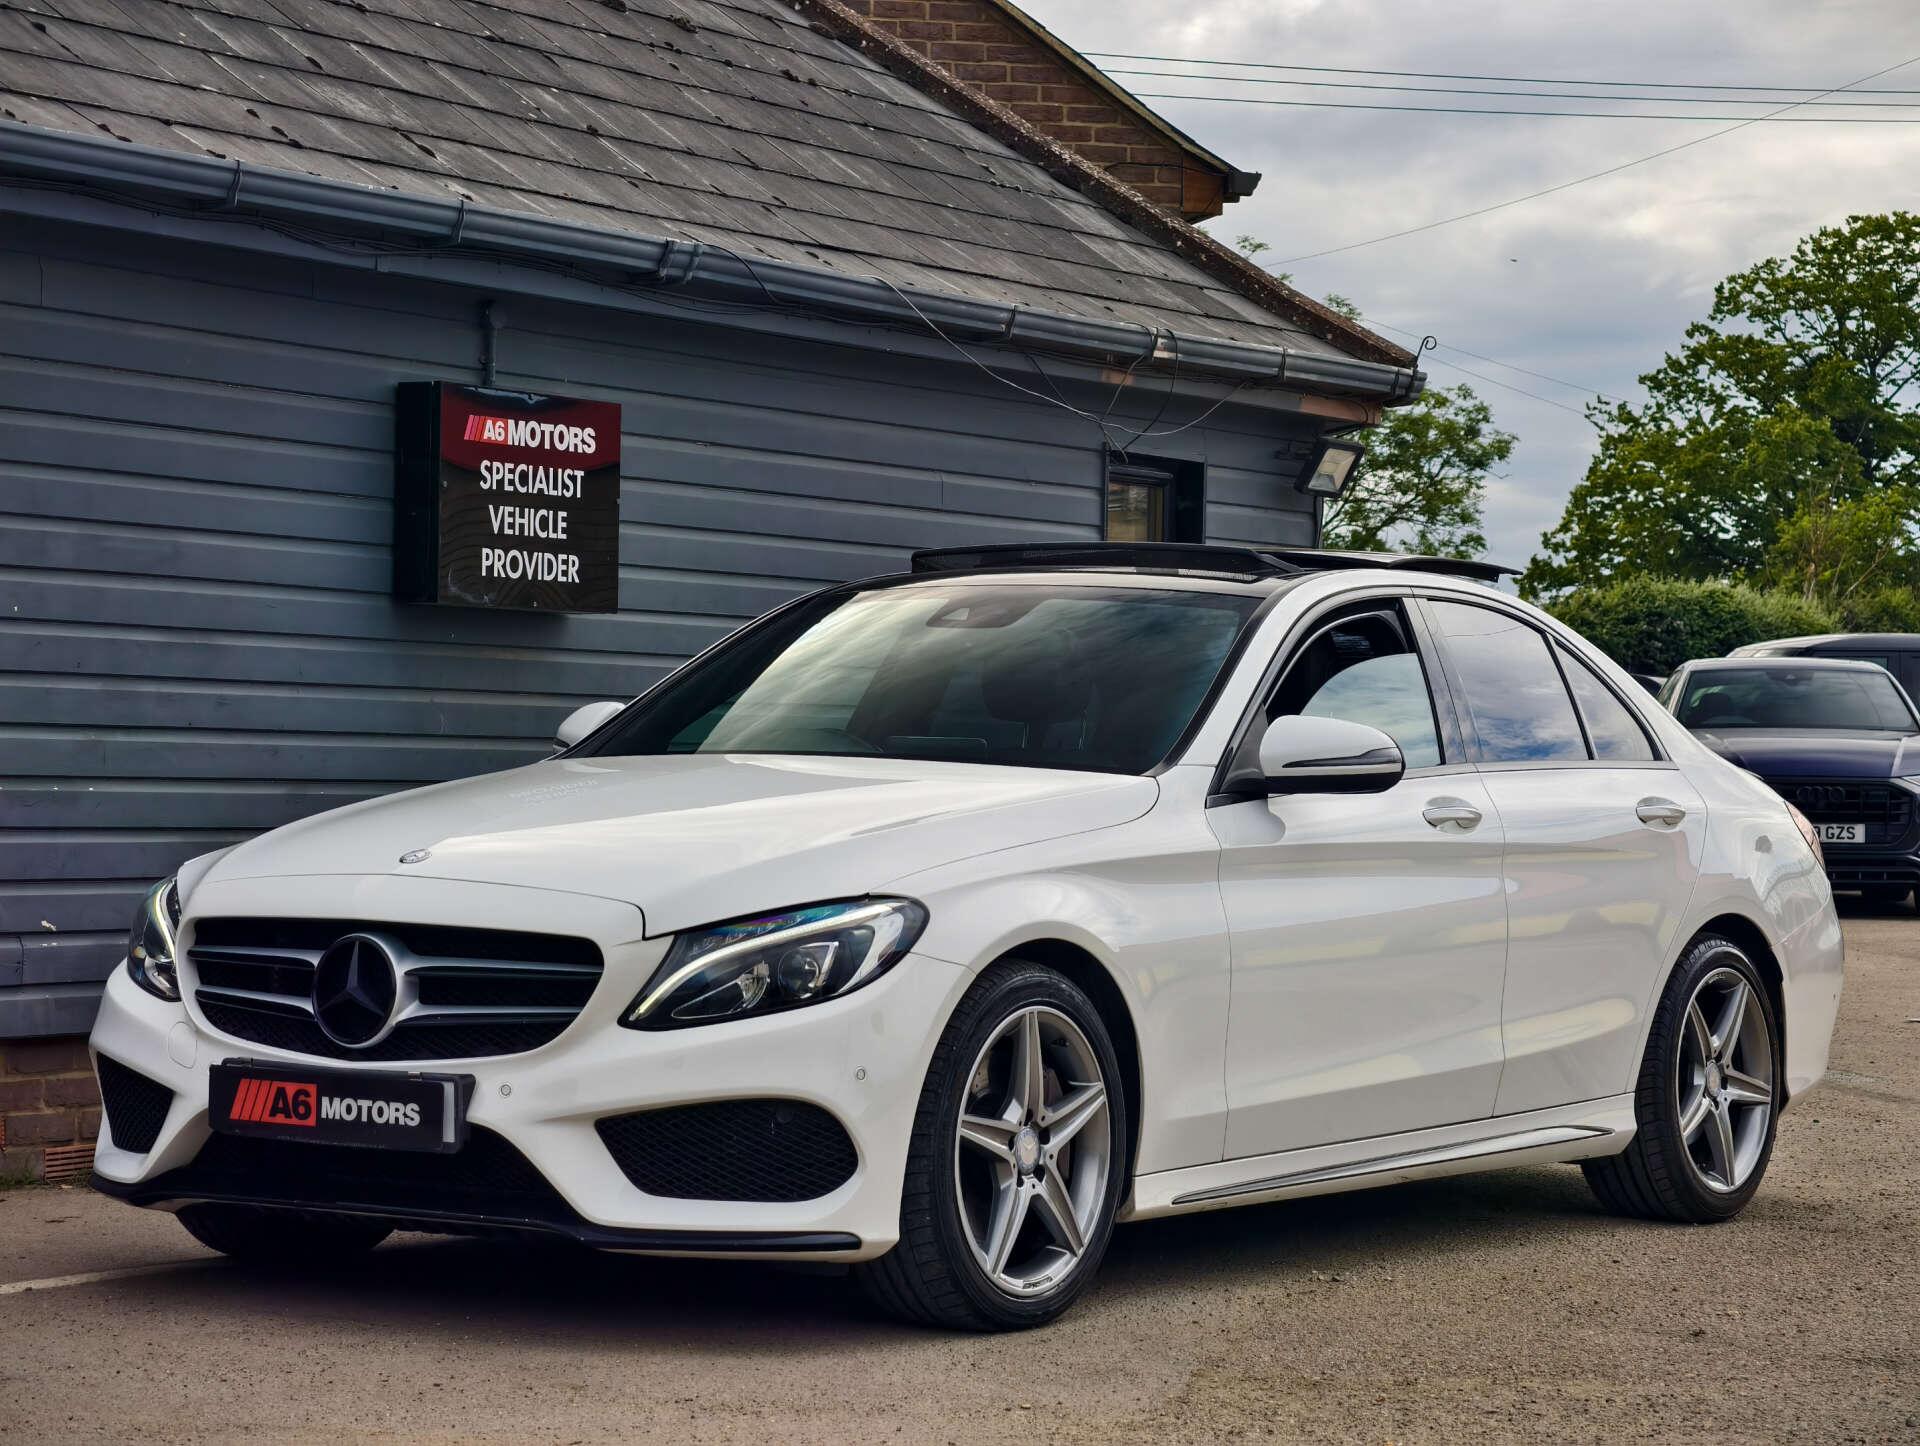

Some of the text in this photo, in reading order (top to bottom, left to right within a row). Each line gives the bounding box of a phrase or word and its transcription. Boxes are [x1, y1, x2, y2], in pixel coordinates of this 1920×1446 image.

[483, 418, 596, 454] A6 MOTORS
[479, 459, 585, 498] SPECIALIST
[488, 504, 568, 540] VEHICLE
[481, 547, 580, 583] PROVIDER
[1825, 826, 1856, 840] GZS
[268, 1086, 421, 1127] A6 MOTORS
